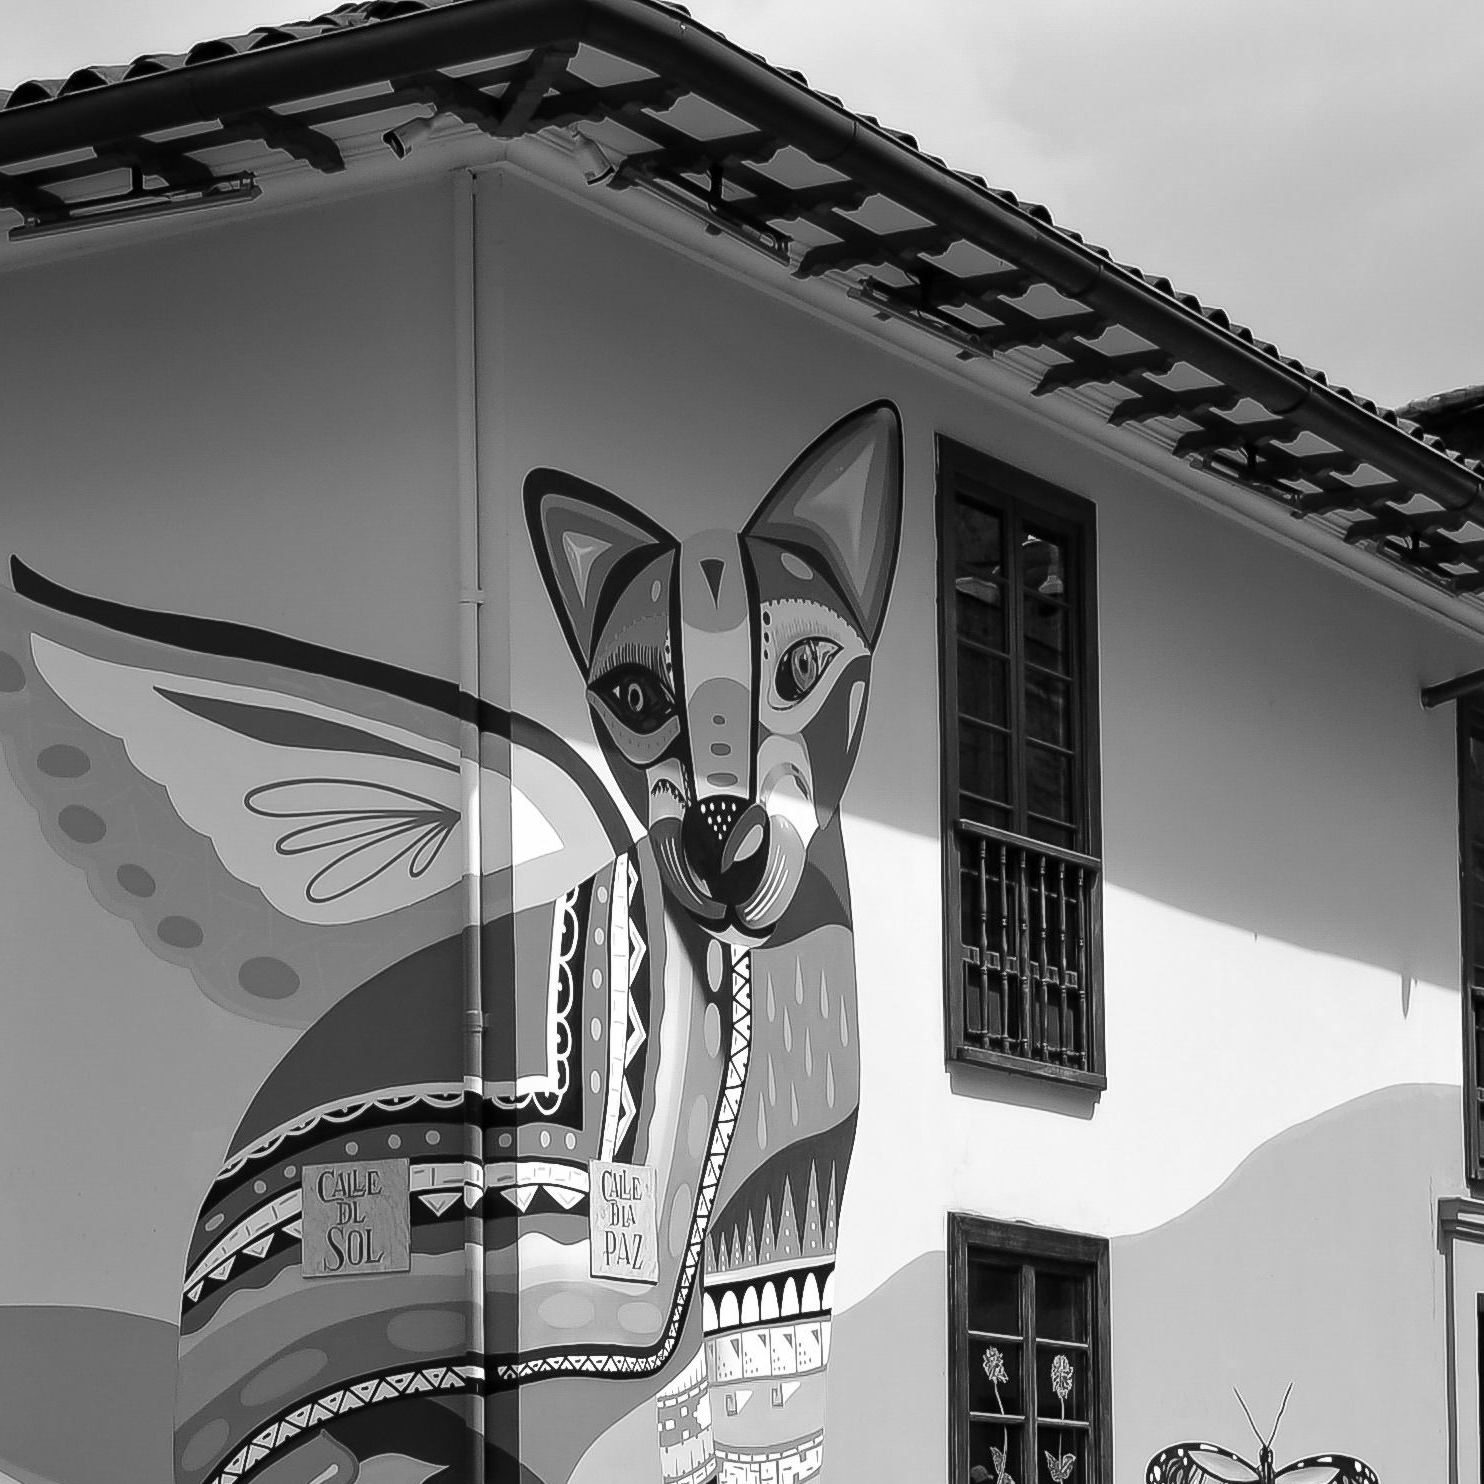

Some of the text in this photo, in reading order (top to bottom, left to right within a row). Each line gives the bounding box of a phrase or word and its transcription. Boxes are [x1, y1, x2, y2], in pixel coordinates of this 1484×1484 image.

[317, 1169, 382, 1203] CALLE
[601, 1168, 643, 1202] CALLE
[323, 1226, 386, 1271] SOL
[603, 1230, 644, 1270] PAZ
